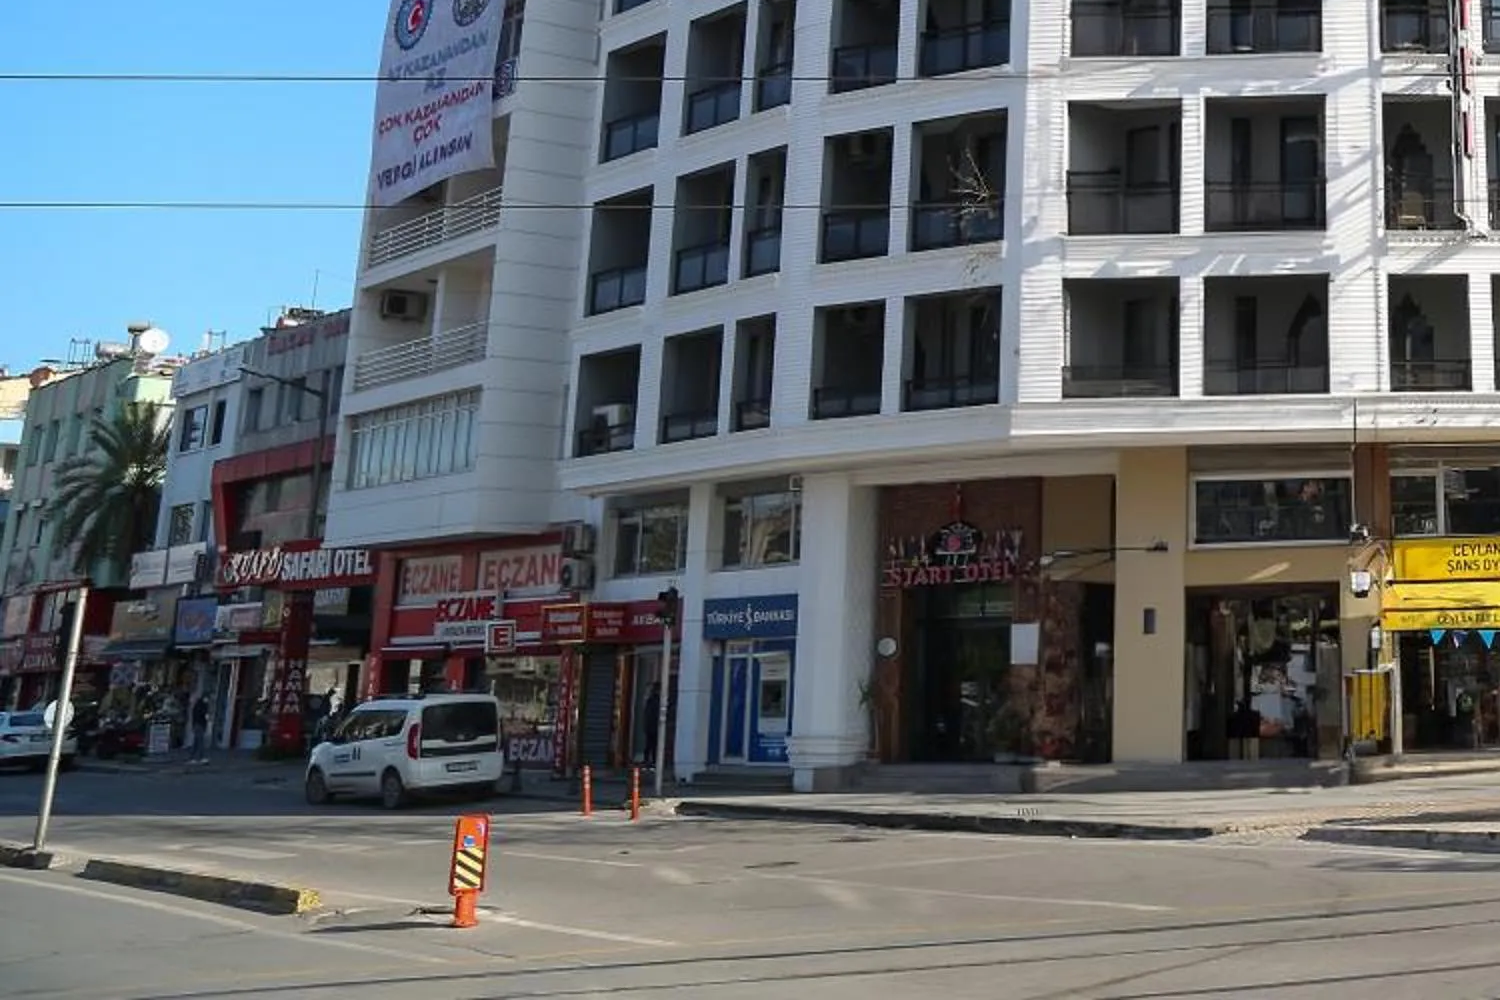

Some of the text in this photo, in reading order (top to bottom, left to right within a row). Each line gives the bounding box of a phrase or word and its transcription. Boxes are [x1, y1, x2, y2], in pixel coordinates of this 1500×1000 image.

[282, 550, 373, 581] SAFARI OTEL
[403, 560, 460, 594] ECZANE
[886, 561, 1014, 586] START OTEL
[1447, 559, 1480, 574] ŞANS
[706, 608, 746, 625] TÜRKİYE
[494, 628, 509, 647] E
[508, 738, 556, 762] ECZAN
